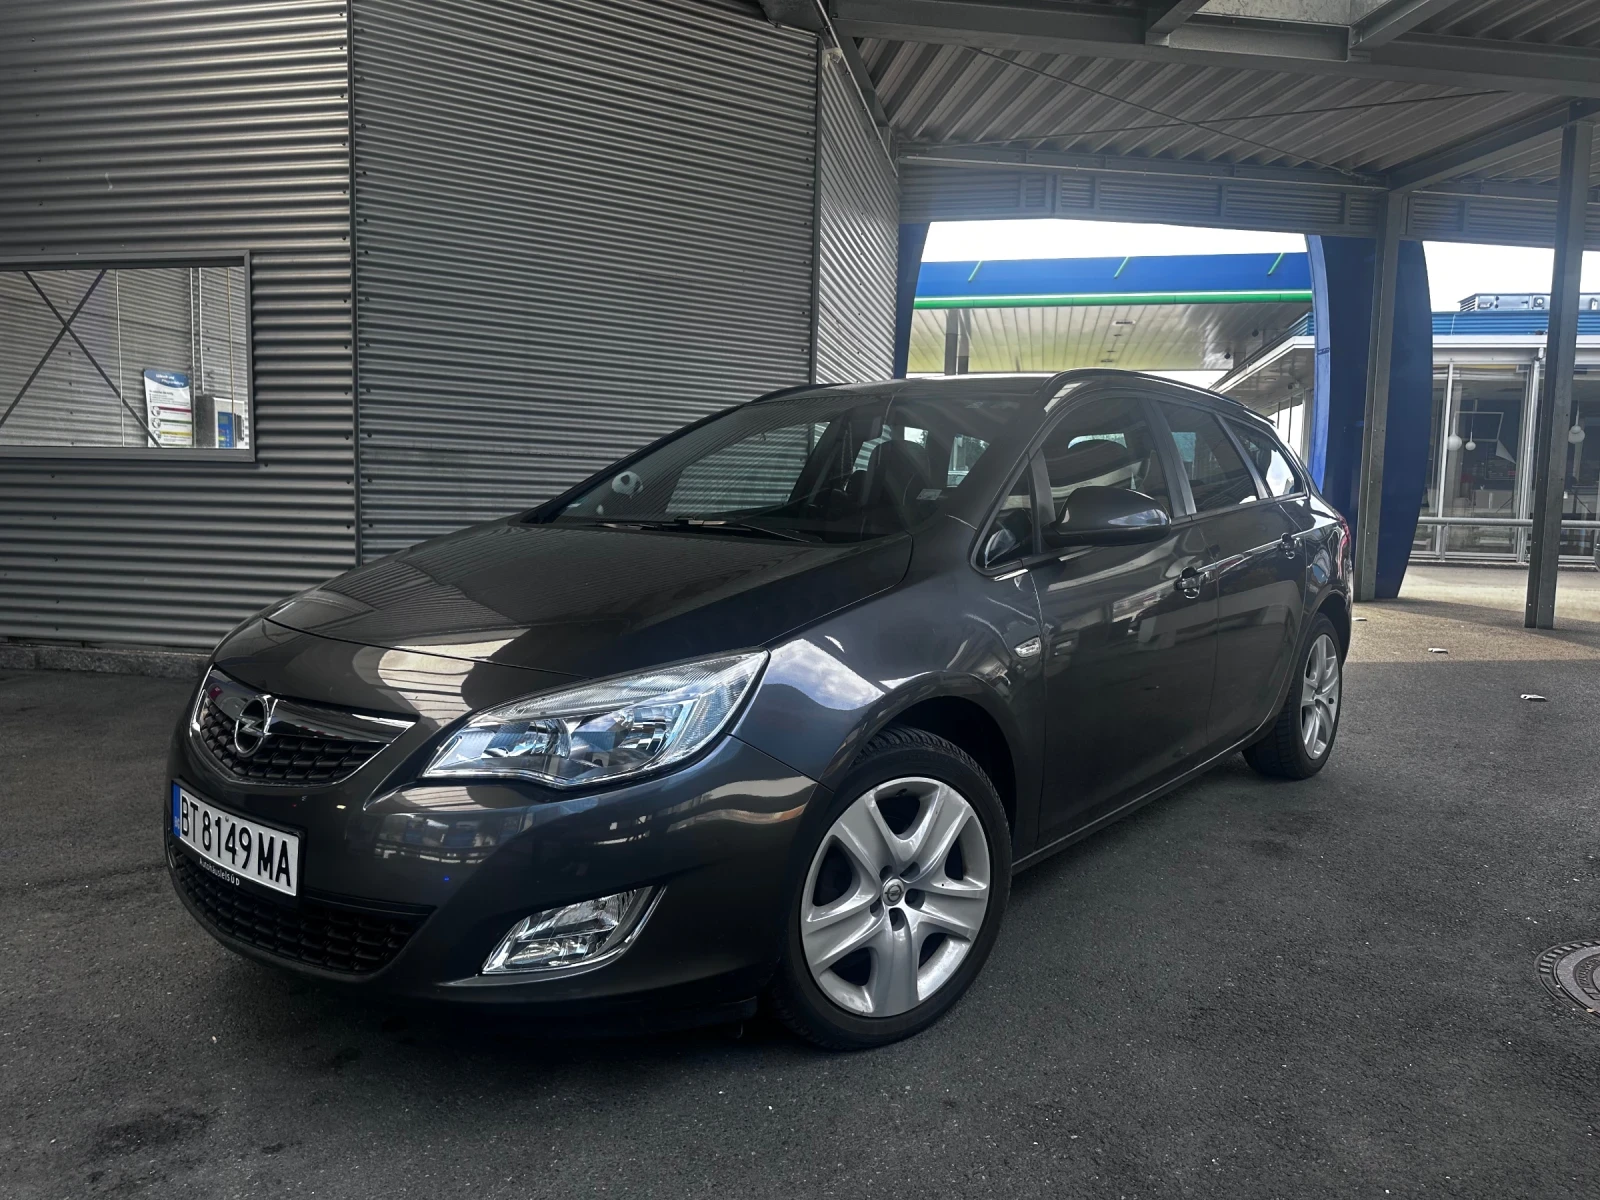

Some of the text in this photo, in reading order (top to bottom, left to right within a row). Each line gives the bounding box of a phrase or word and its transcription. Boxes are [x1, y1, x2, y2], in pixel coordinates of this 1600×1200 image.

[182, 795, 292, 887] BT 8149 MA
